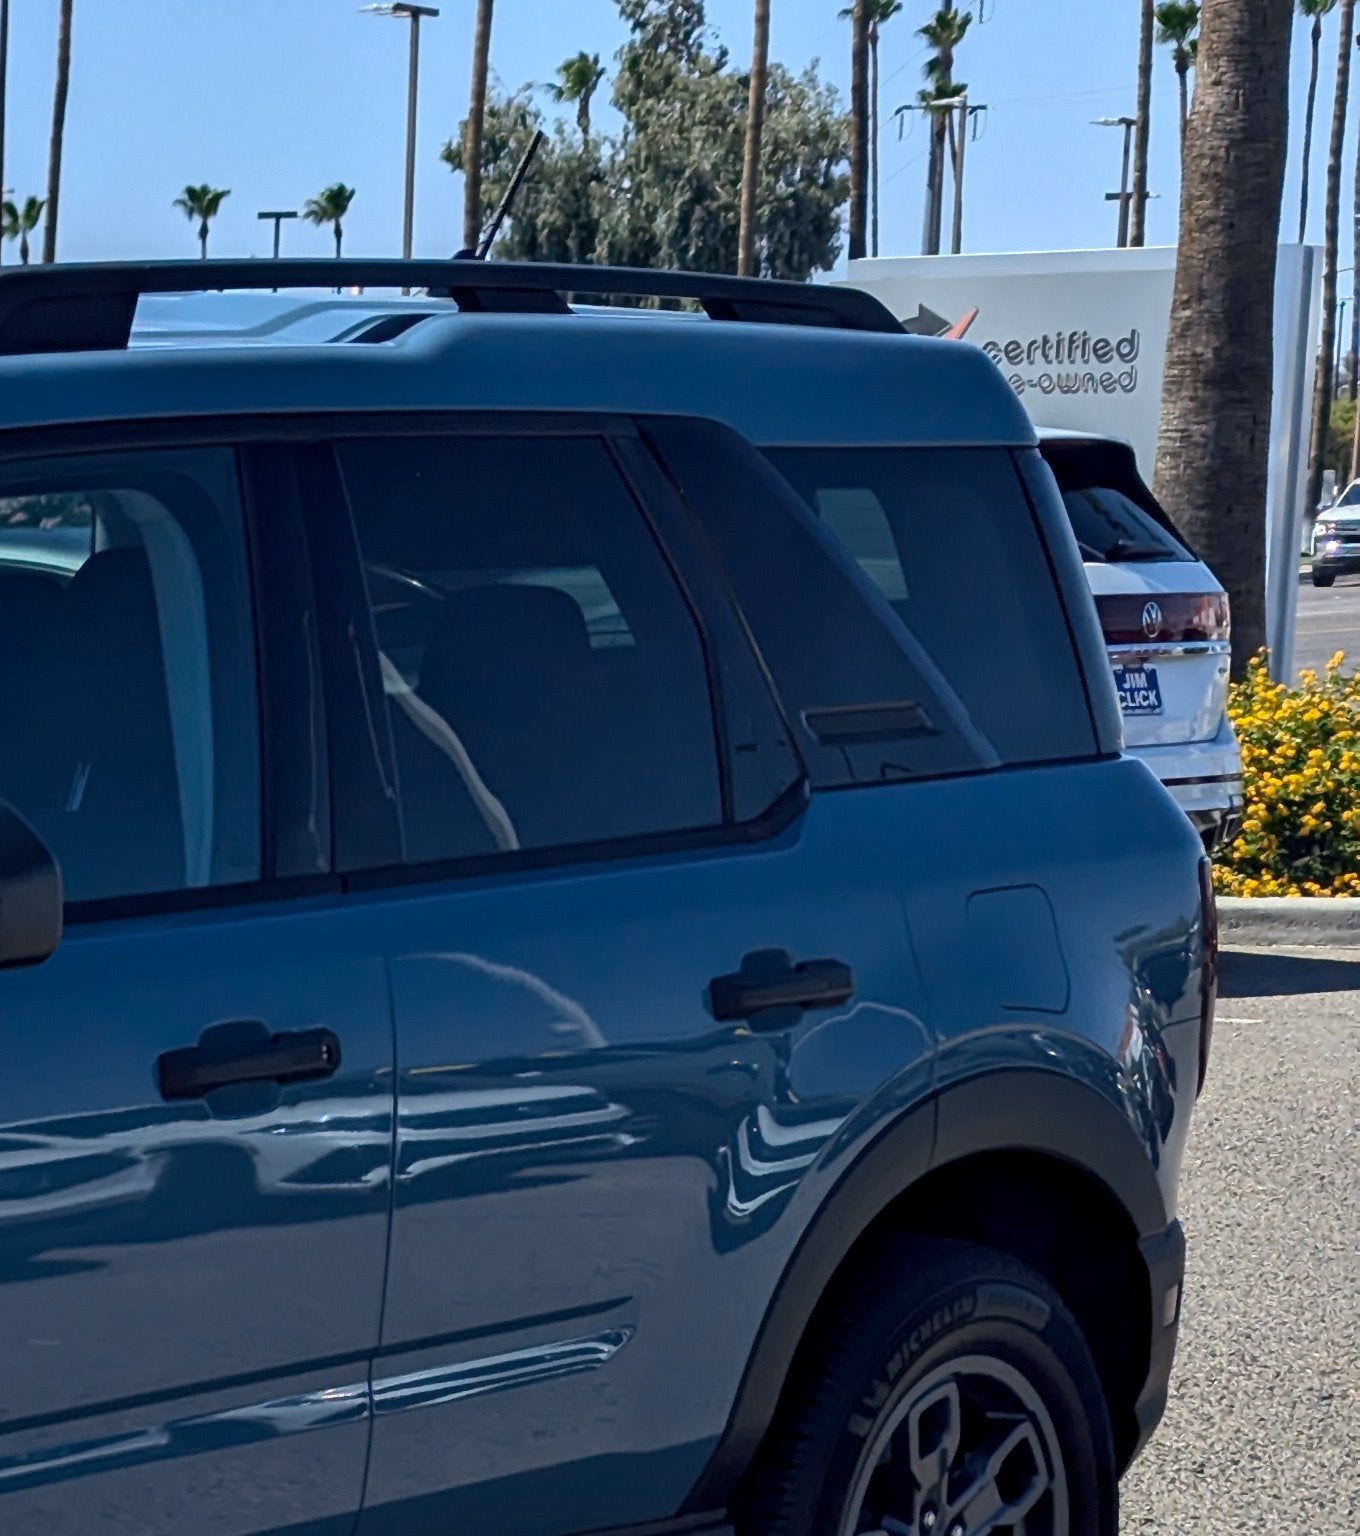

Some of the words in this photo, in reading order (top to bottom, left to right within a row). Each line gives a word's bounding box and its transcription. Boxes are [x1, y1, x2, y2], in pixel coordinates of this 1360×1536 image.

[982, 328, 1140, 366] certified
[1008, 365, 1138, 396] e-owned
[1122, 672, 1148, 689] JIM
[1118, 689, 1159, 707] CLICK
